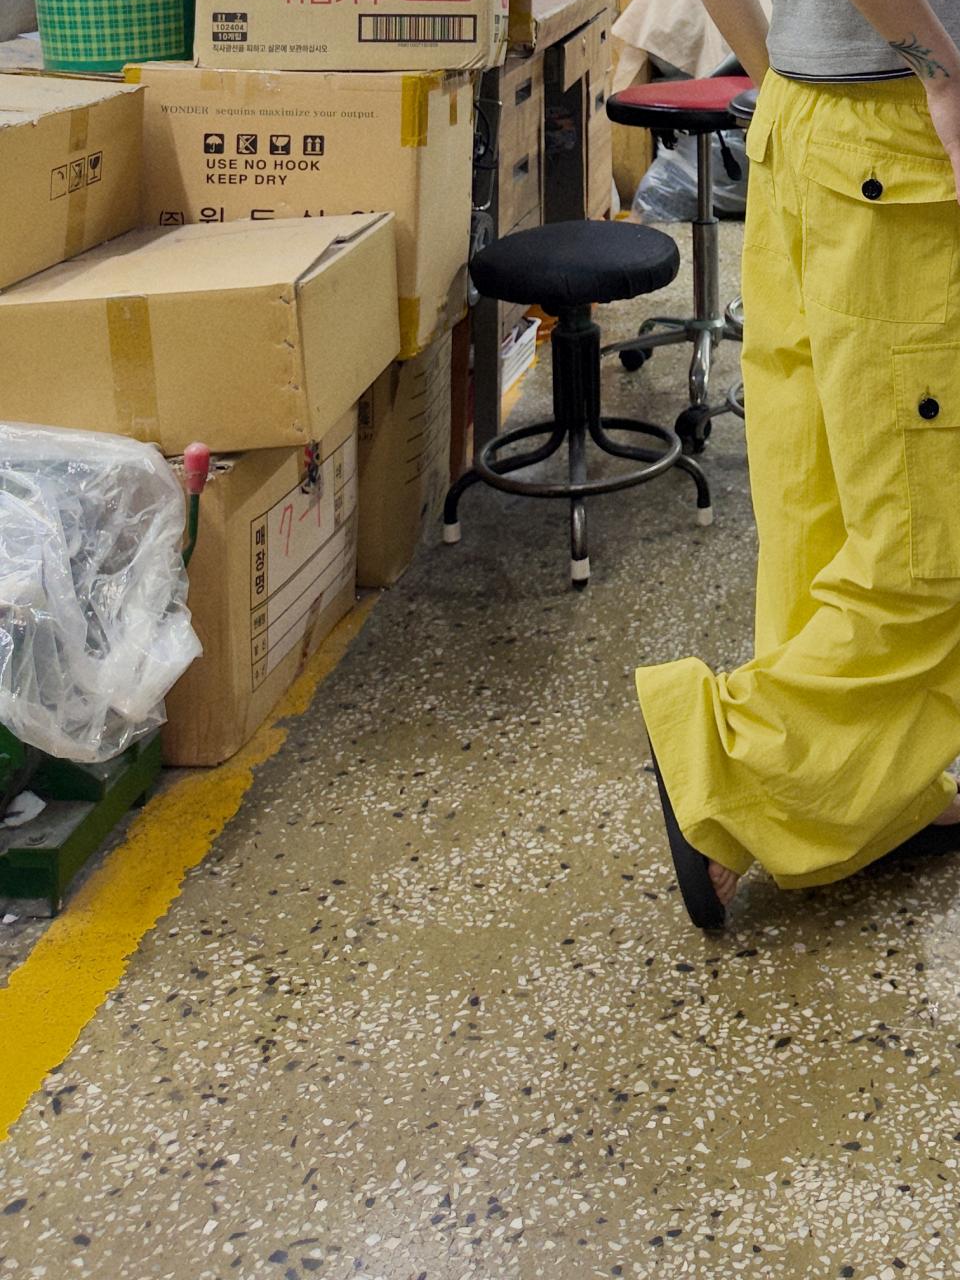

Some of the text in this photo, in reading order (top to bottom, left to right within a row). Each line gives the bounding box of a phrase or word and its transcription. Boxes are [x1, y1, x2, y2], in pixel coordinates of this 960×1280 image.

[160, 105, 209, 115] WONDER
[215, 108, 256, 117] sequins
[259, 109, 310, 117] maximize
[206, 159, 320, 171] USE NO HOOK
[206, 174, 288, 185] KEEP DRY
